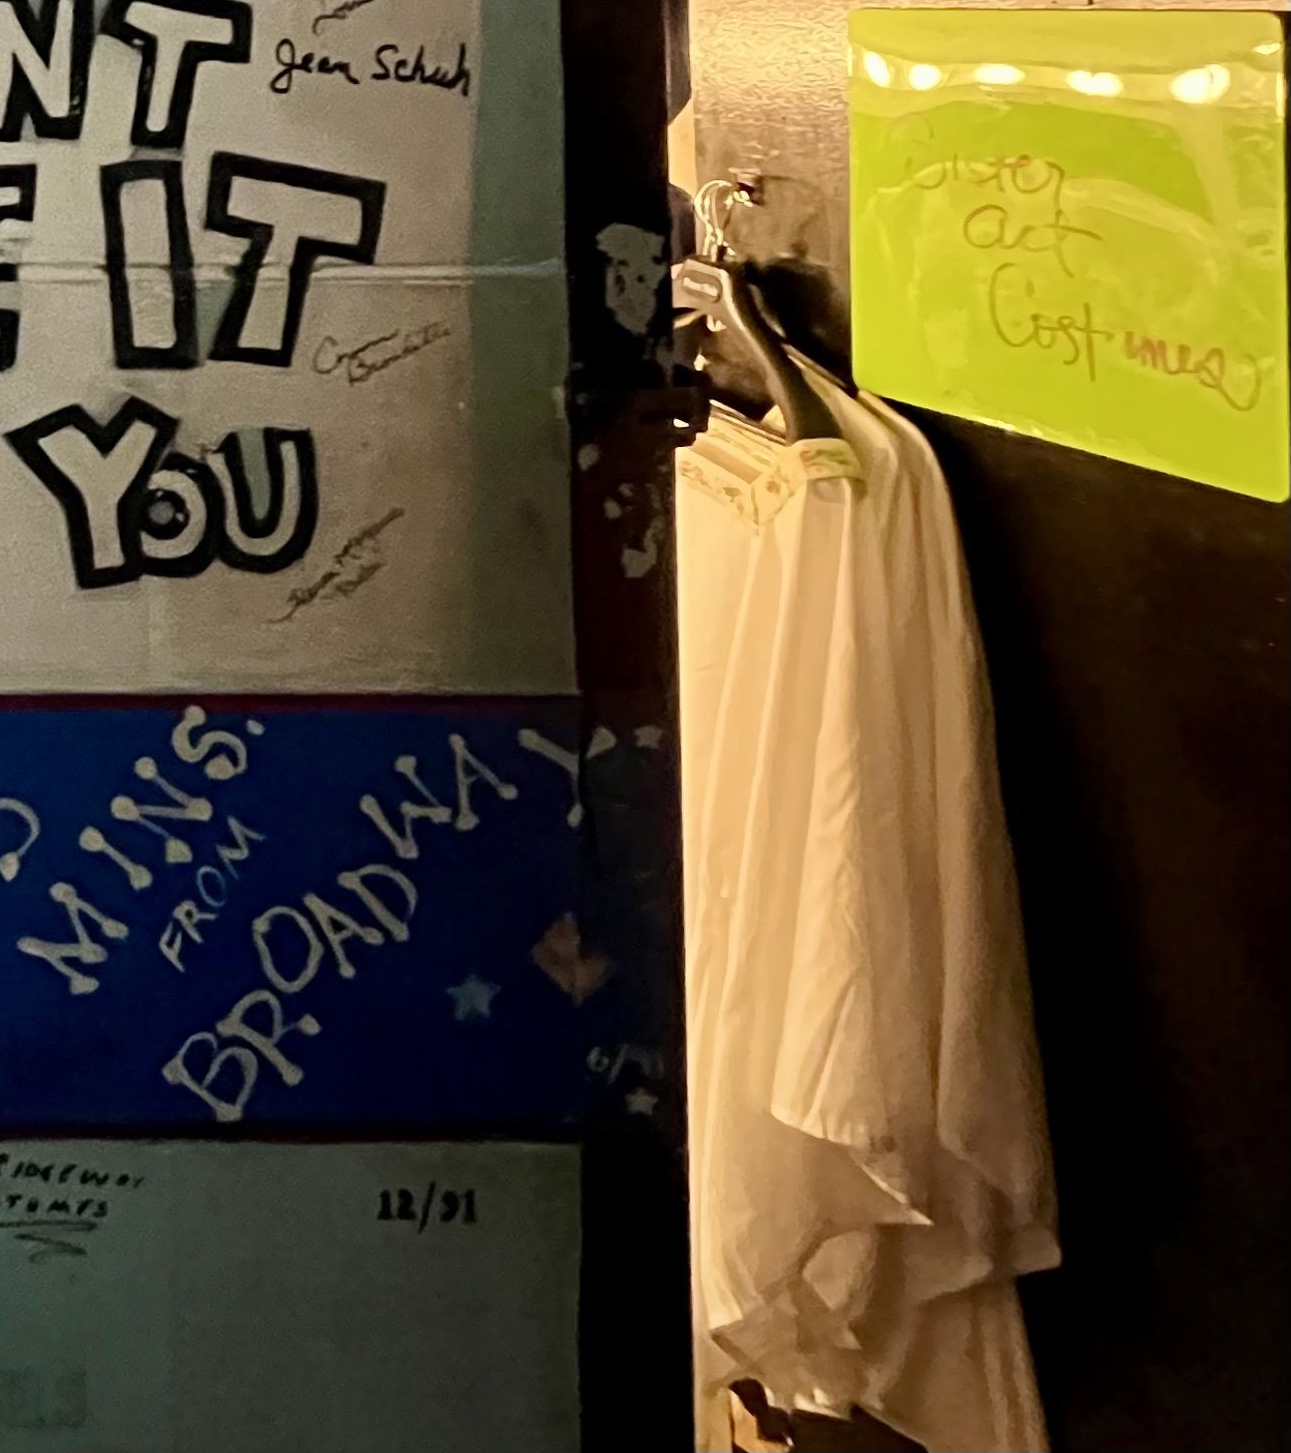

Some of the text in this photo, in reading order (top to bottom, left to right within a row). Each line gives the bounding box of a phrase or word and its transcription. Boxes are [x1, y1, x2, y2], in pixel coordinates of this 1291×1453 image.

[98, 150, 387, 370] IT
[158, 815, 267, 973] FROM
[160, 726, 616, 1123] BROADWAY
[375, 1180, 479, 1236] 12/91
